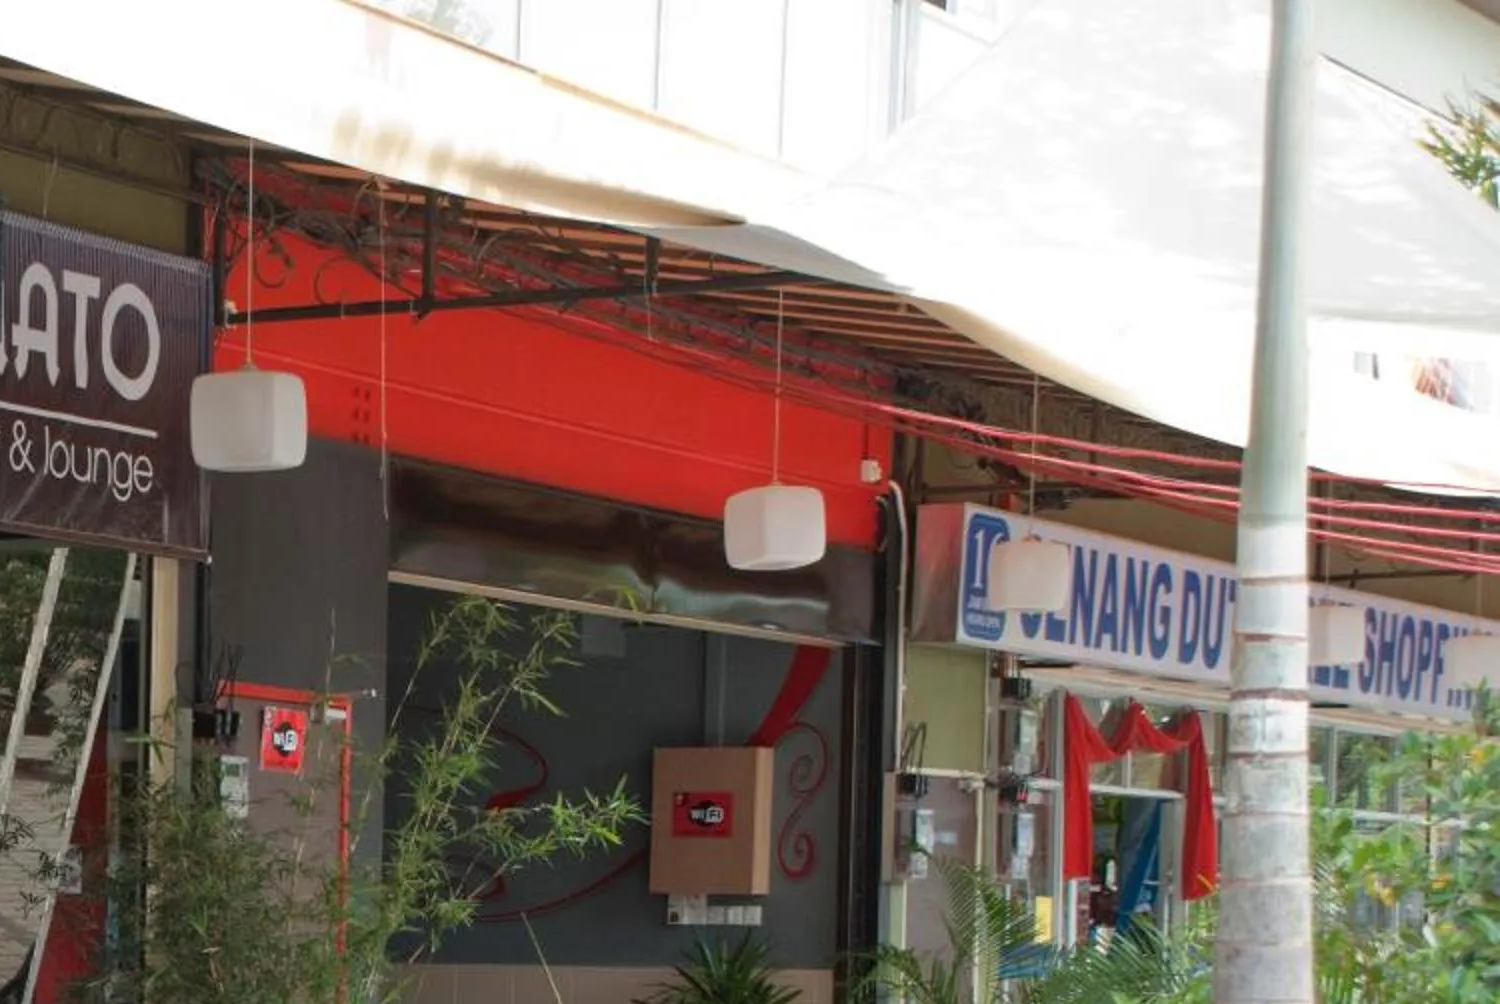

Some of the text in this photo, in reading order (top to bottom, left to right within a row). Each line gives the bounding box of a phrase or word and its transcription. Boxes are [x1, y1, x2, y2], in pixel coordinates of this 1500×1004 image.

[9, 419, 35, 473] &
[44, 425, 154, 502] lounge
[1020, 540, 1173, 661] NANG
[1177, 569, 1237, 669] DU
